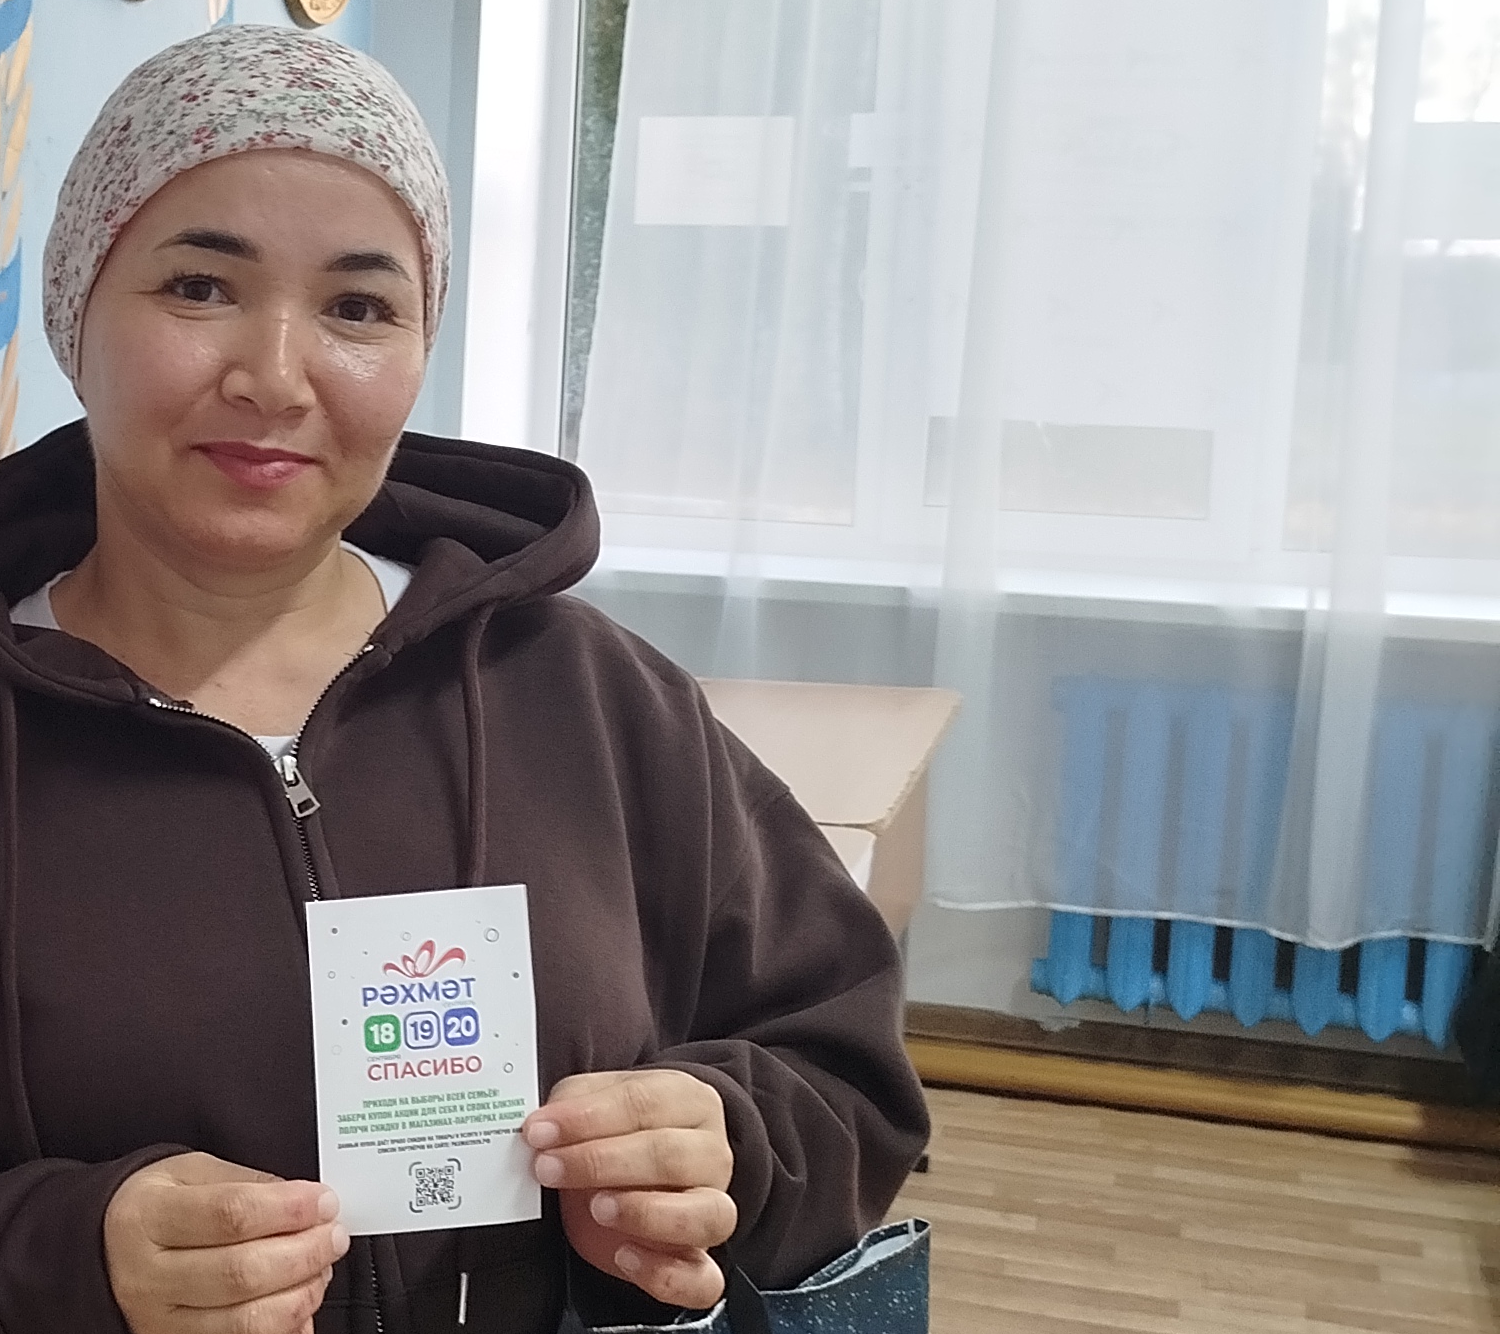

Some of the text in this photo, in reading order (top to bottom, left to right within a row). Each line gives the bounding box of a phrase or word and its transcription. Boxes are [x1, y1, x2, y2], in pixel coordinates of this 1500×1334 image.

[362, 977, 477, 1007] РӘХМӘТ
[369, 1015, 476, 1045] 18 19 20
[367, 1055, 483, 1082] СПАСИБО
[337, 1112, 367, 1123] ЗАБЕРИ
[368, 1111, 393, 1120] КУПОН
[394, 1108, 420, 1119] АКЦИИ
[421, 1107, 437, 1117] ДЛЯ
[438, 1105, 458, 1115] СЕБЯ
[466, 1102, 491, 1113] СВОИХ
[363, 1098, 398, 1109] ПРИХОДИ
[399, 1097, 410, 1105] НА
[411, 1093, 445, 1105] ВЫБОРЫ
[339, 1124, 369, 1135] ПОЛУЧИ
[370, 1122, 400, 1133] СКИДКУ
